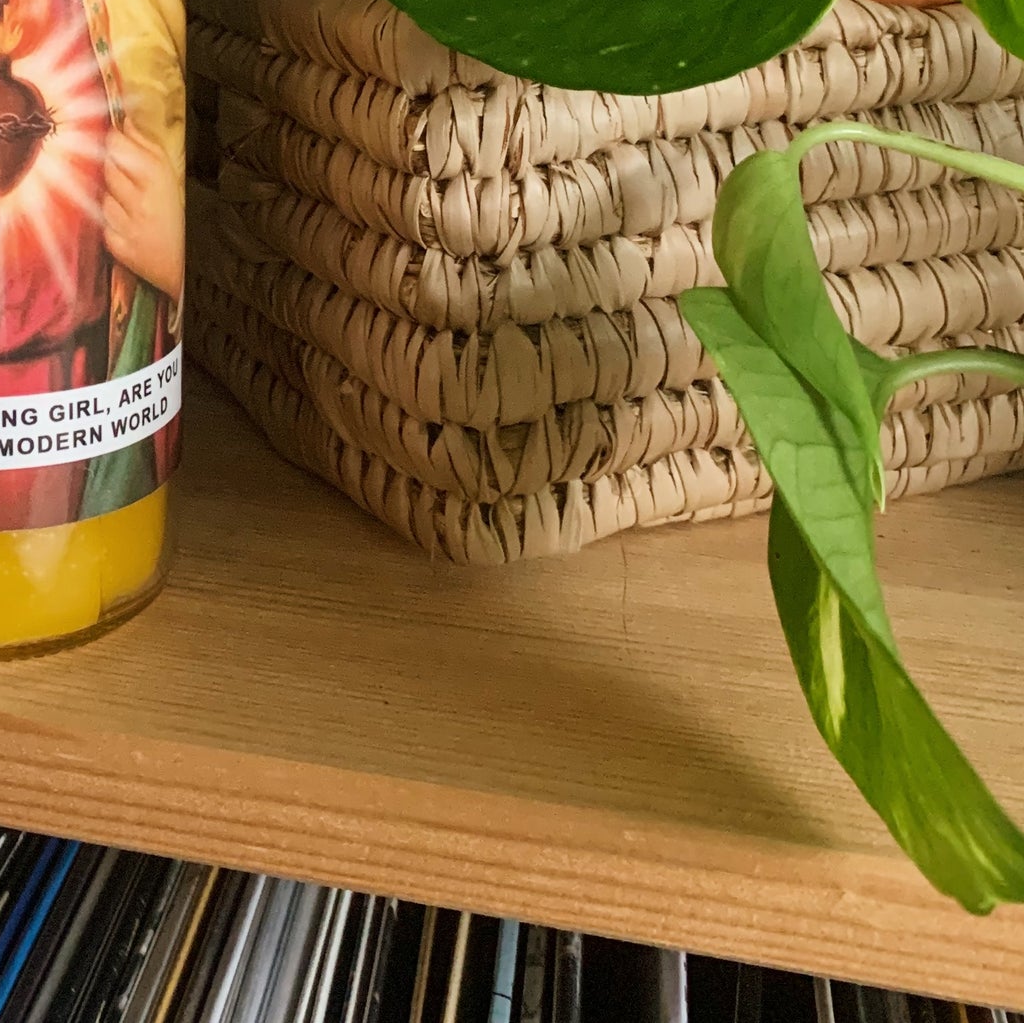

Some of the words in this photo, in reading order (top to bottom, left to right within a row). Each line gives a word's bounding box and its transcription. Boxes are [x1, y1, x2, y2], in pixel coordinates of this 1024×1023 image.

[49, 396, 111, 423] GIRL,
[119, 378, 153, 408] ARE
[157, 356, 178, 387] YOU
[111, 395, 168, 438] WORLD
